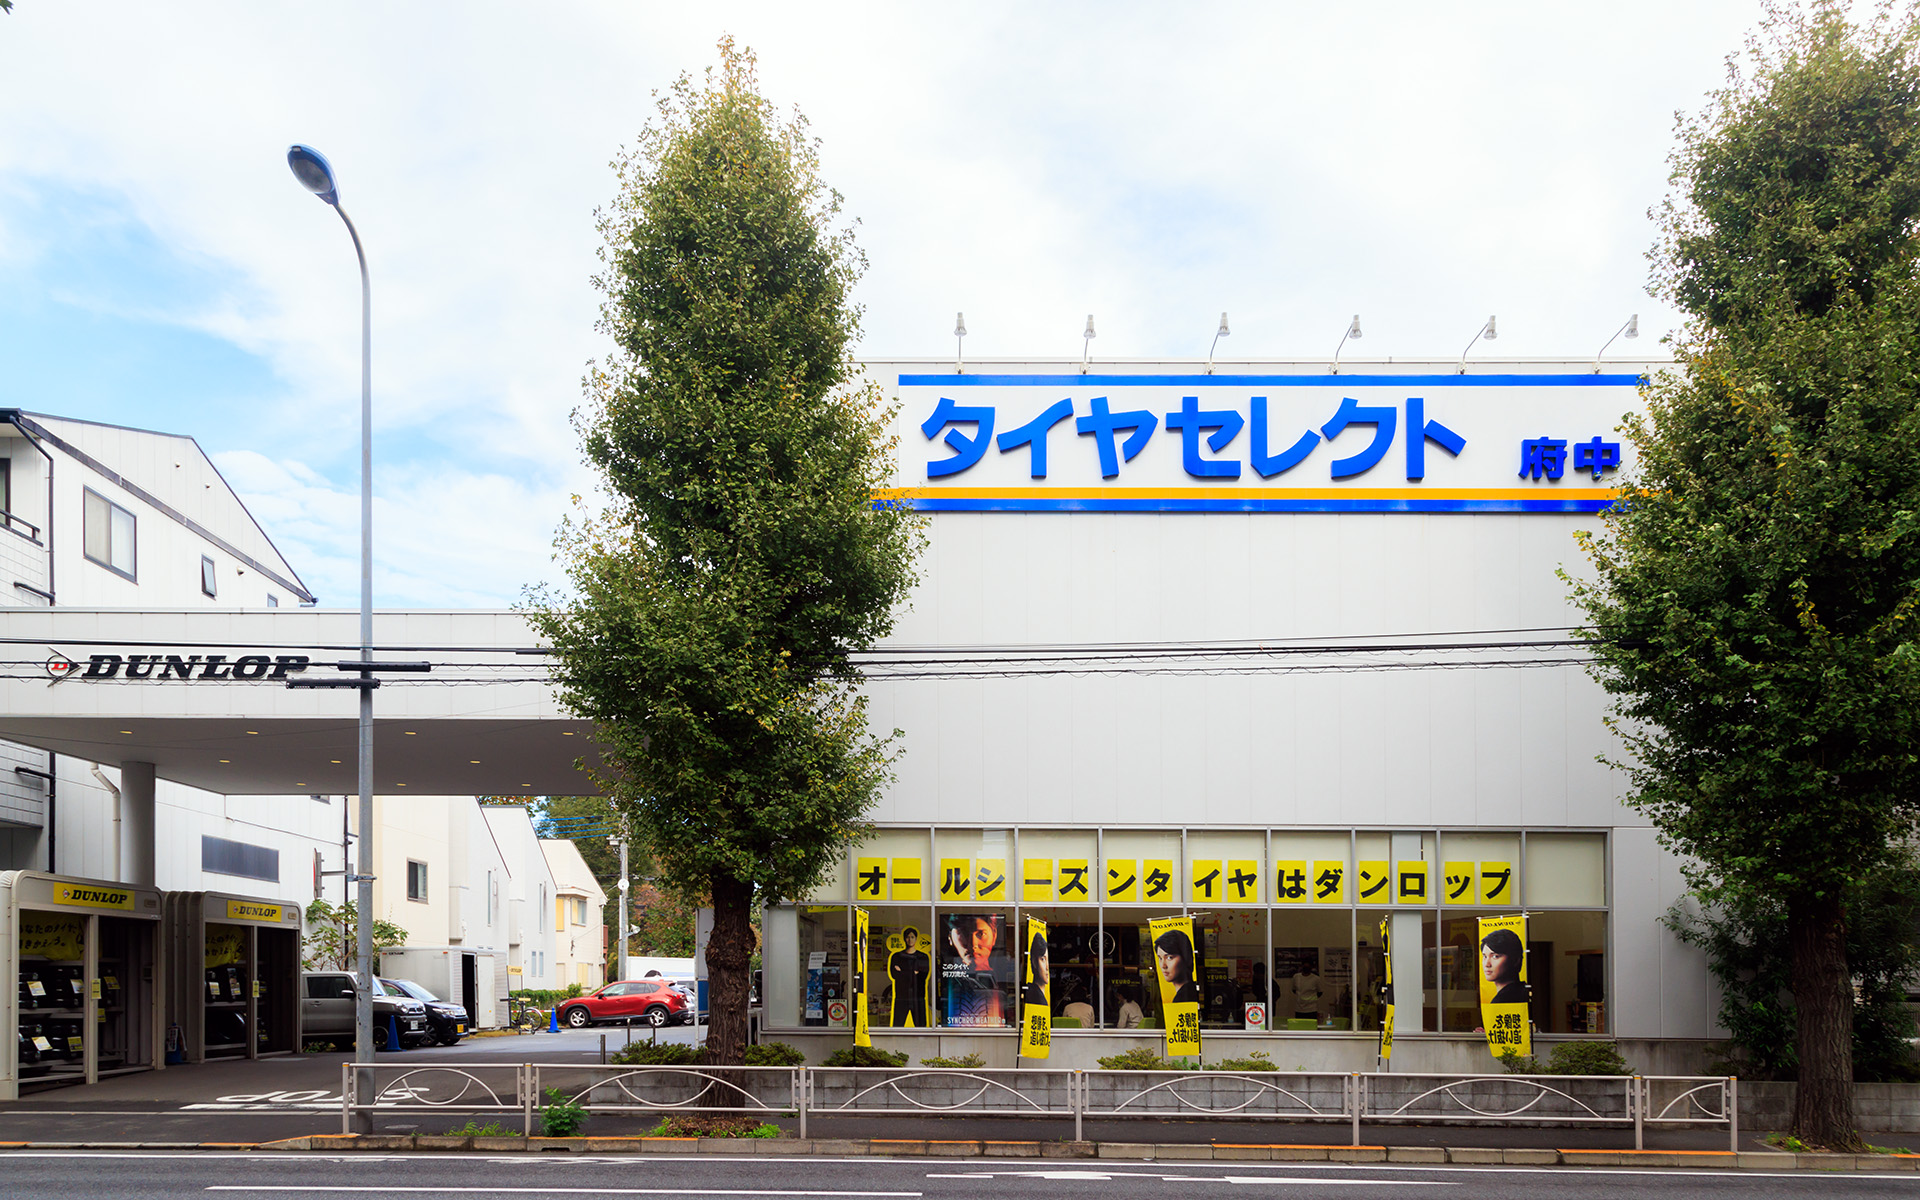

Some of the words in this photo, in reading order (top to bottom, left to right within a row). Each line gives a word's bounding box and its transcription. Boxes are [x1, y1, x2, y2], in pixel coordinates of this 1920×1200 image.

[921, 396, 1467, 480] タイヤセレクト
[1518, 436, 1621, 480] 府中
[81, 655, 310, 680] DUNLOP
[858, 866, 1511, 899] オールシーズンタイヤはダンロップ
[71, 889, 128, 904] DUNLOP
[239, 905, 277, 917] DUNLOP
